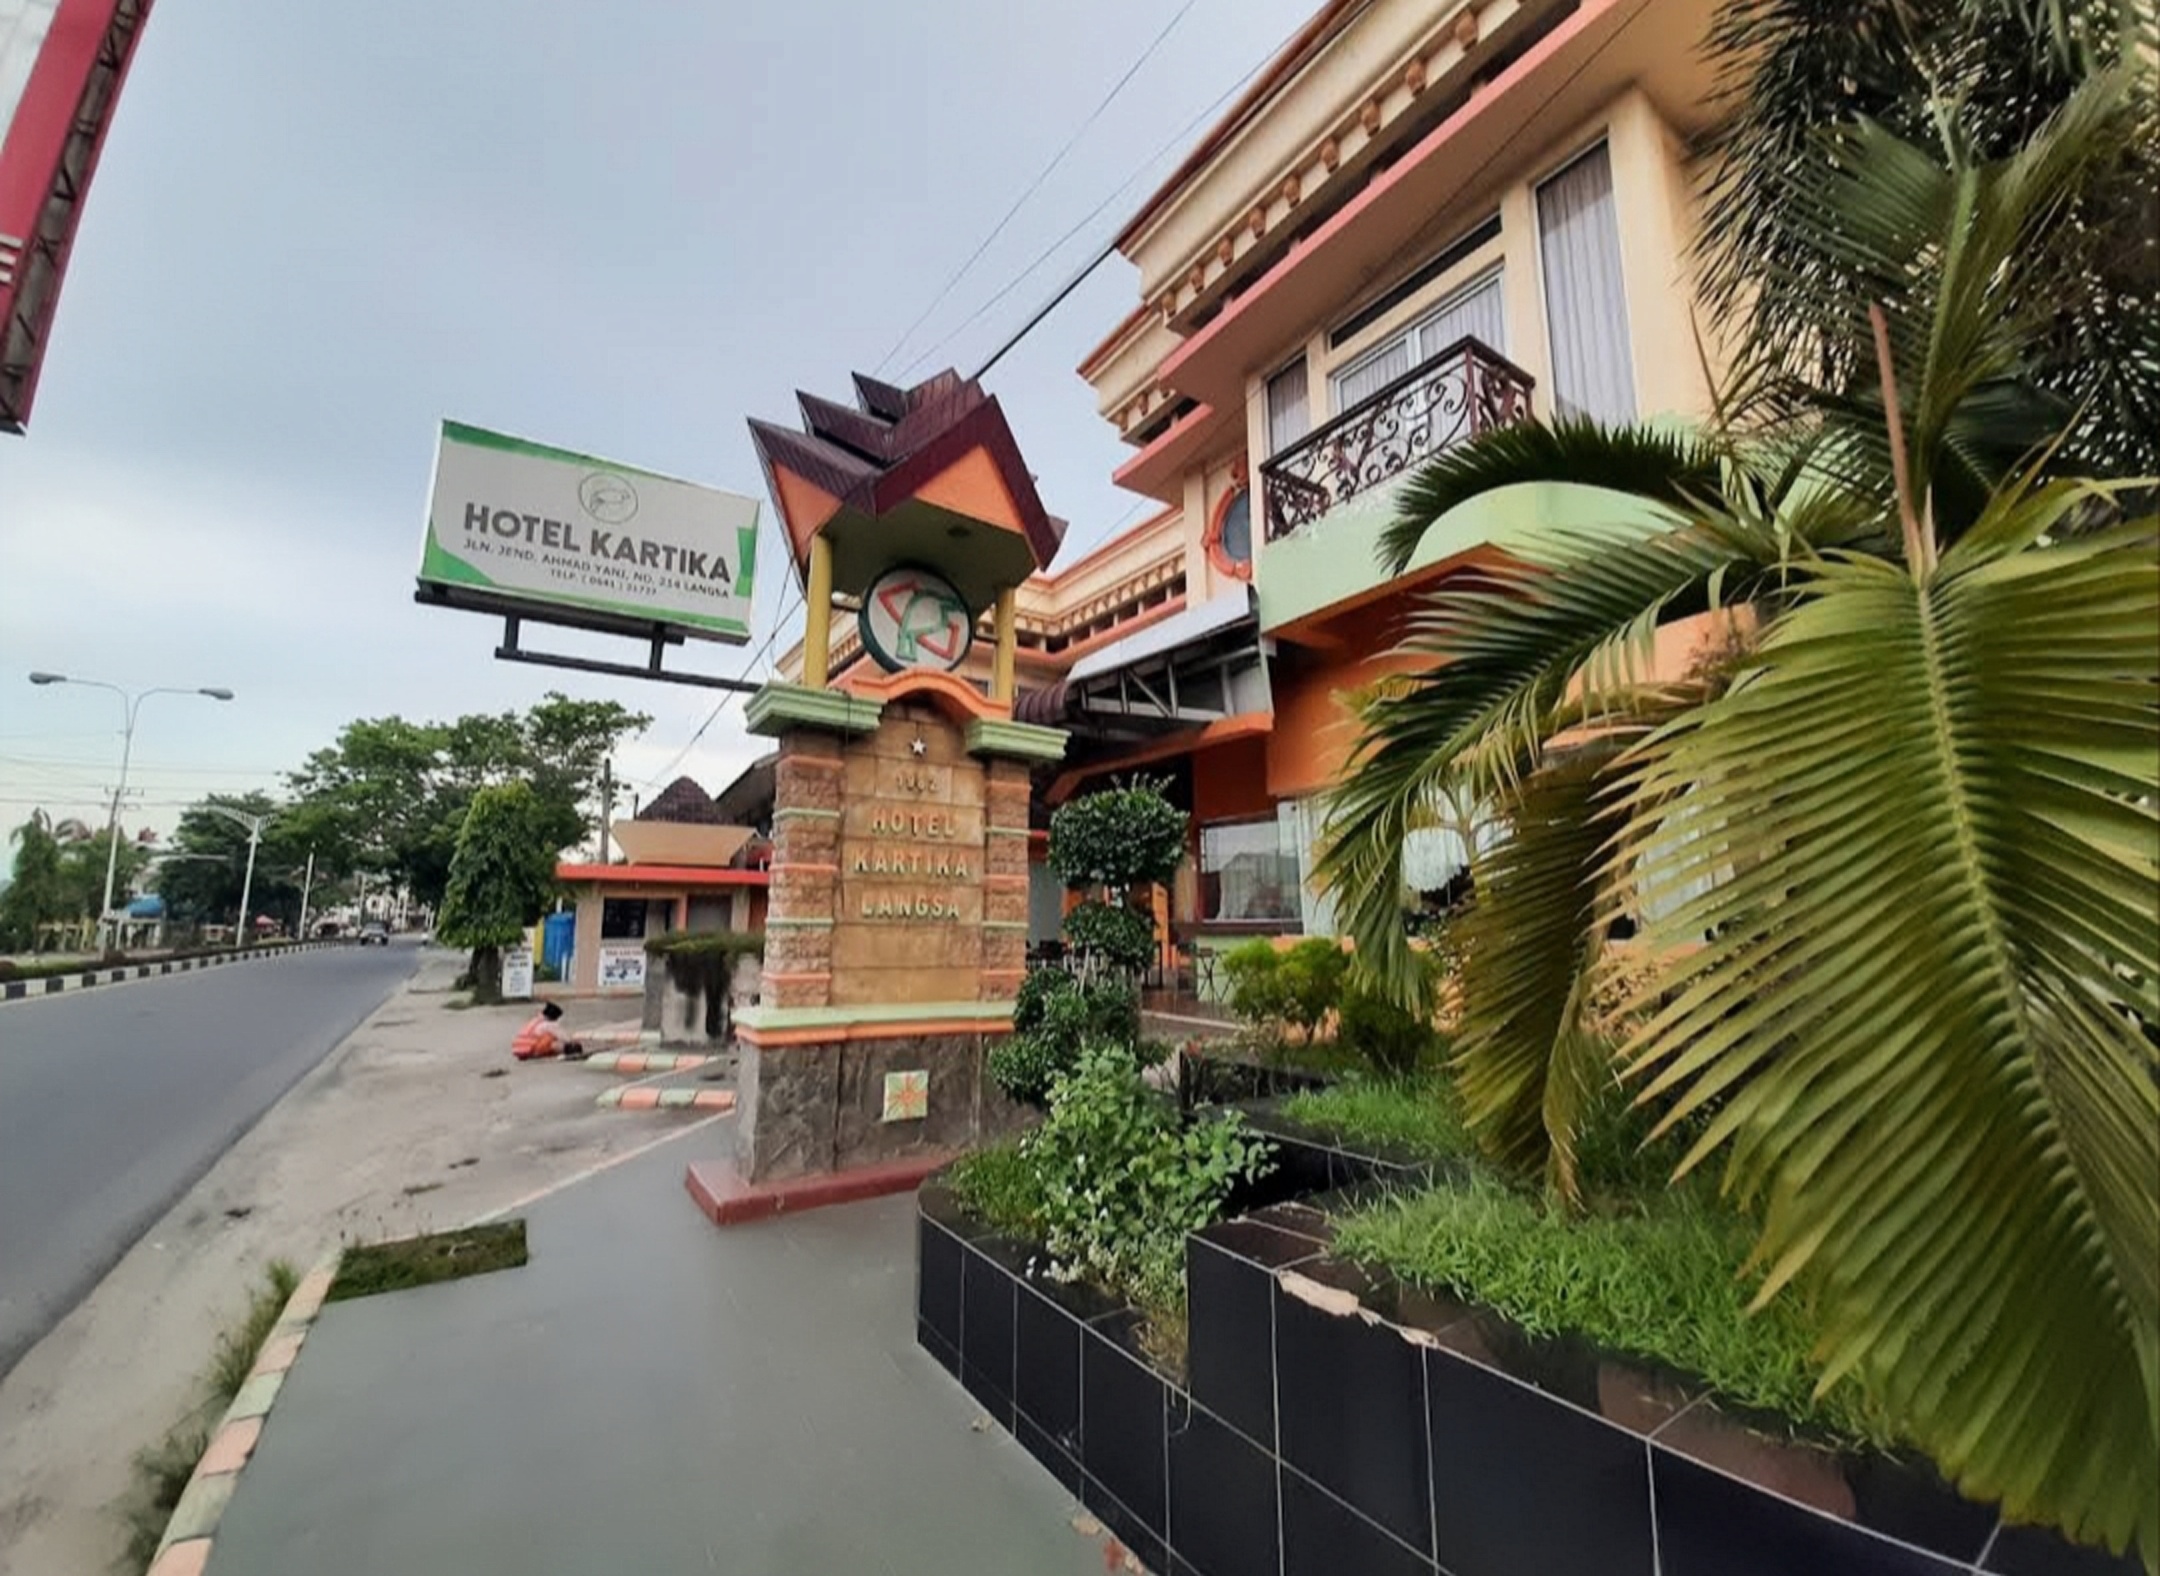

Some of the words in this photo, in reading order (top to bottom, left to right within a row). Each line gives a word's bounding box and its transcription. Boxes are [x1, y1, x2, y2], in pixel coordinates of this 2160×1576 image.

[464, 502, 580, 552] HOTEL
[590, 529, 731, 584] KARTIKA
[464, 538, 494, 554] JLN.
[542, 553, 591, 572] AHMAD
[683, 582, 729, 599] LANGSA
[872, 810, 955, 836] HOTEL
[854, 849, 968, 877] KARTIKA
[861, 891, 960, 918] LANGSA
